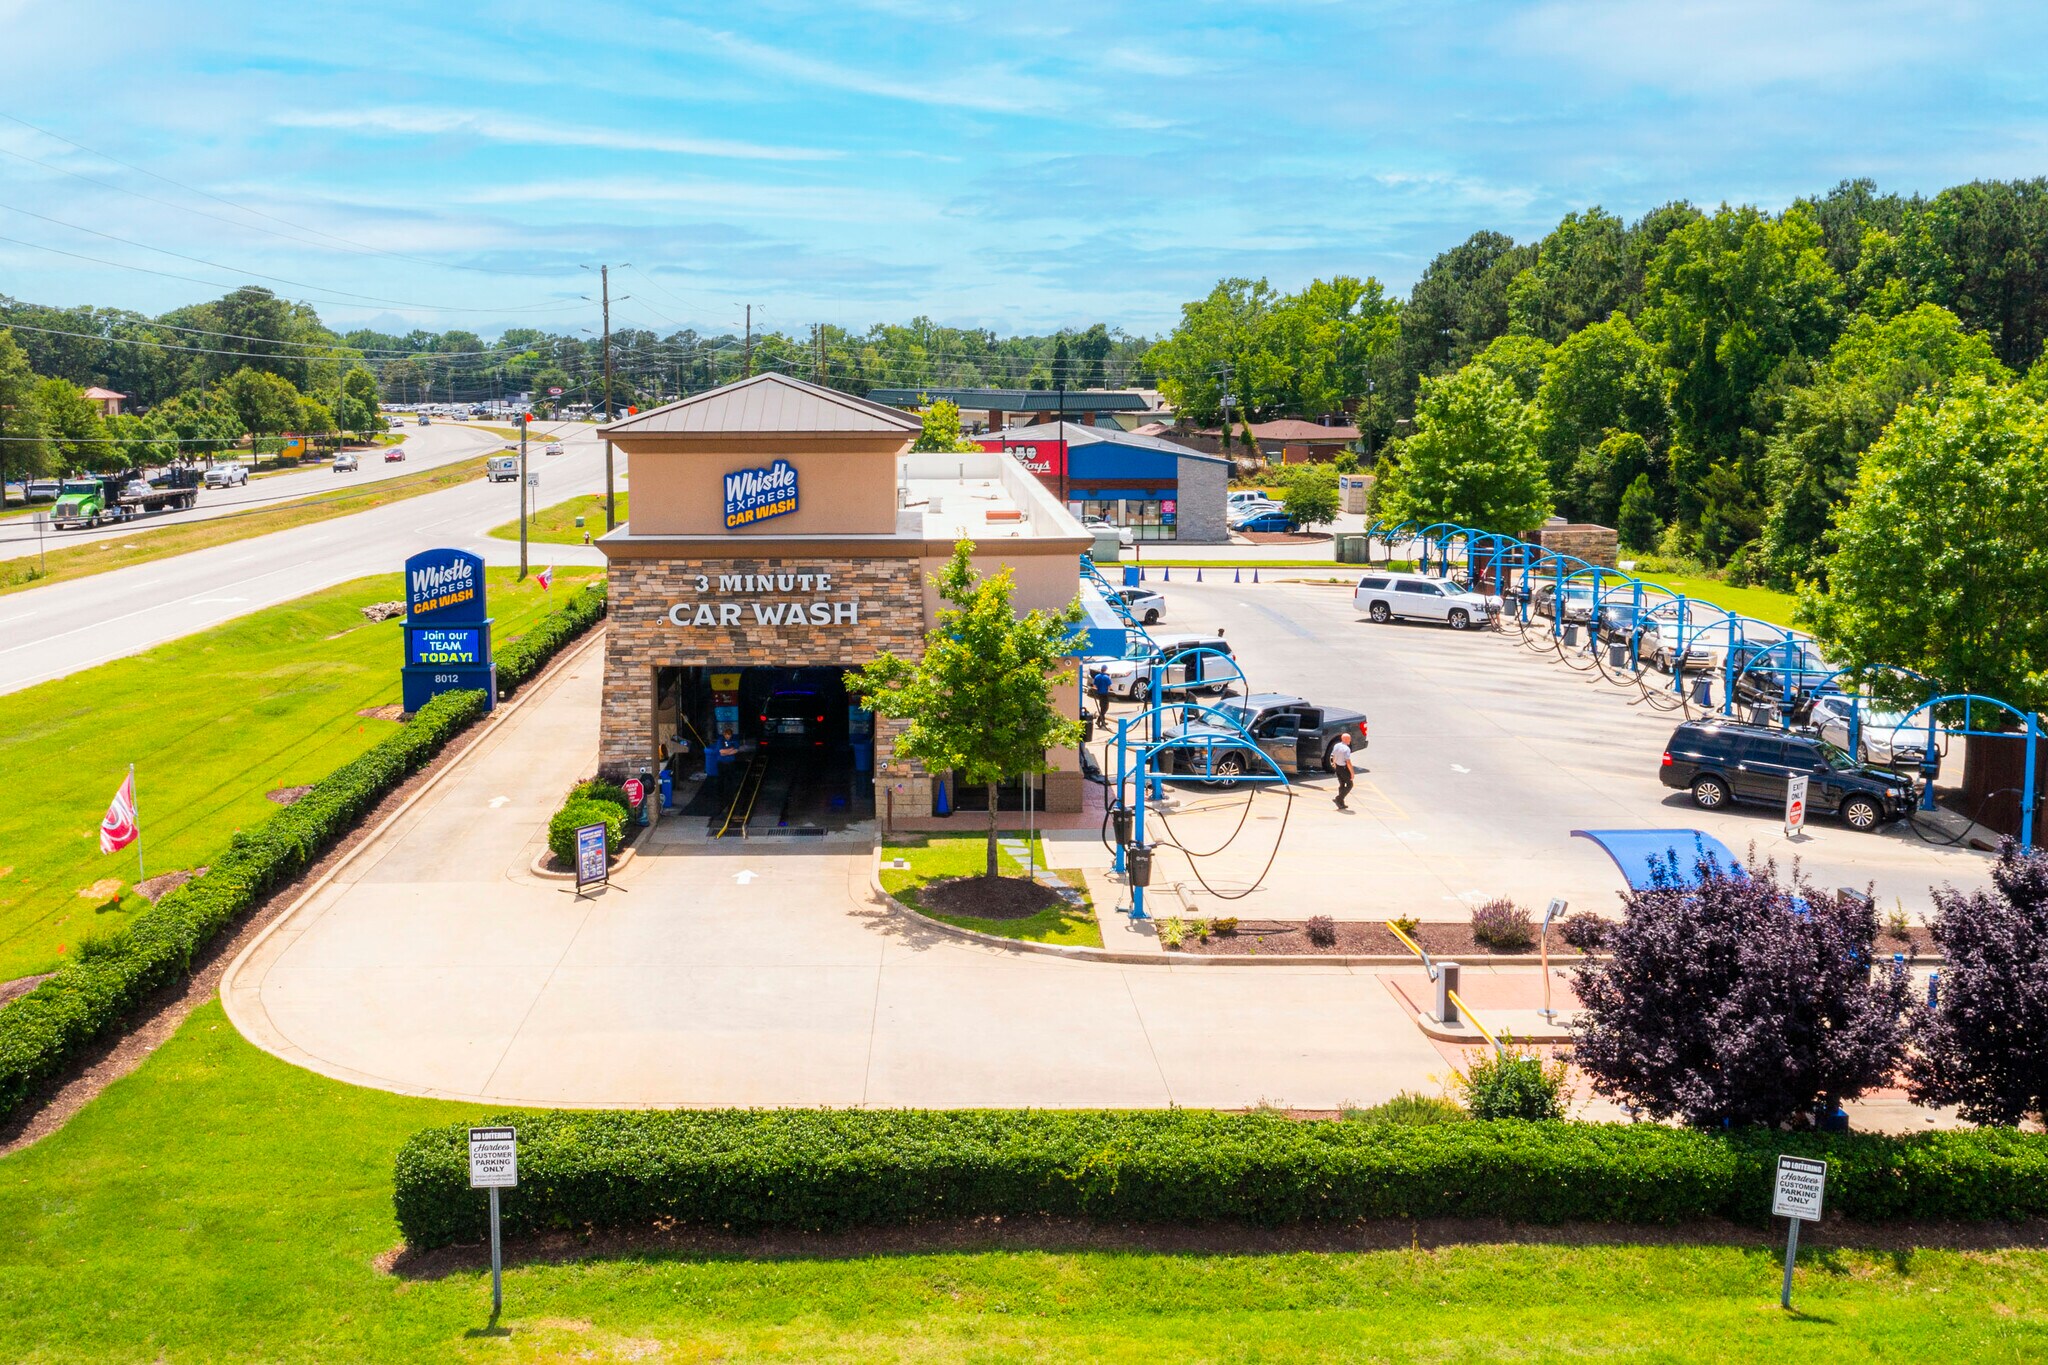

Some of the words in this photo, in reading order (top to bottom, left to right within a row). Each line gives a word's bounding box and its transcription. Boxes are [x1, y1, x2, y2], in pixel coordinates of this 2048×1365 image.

[727, 462, 795, 502] Whistle
[727, 487, 796, 514] EXPRESS
[727, 509, 754, 528] CAR
[756, 498, 796, 519] WASH
[413, 558, 472, 592] Whistle
[695, 574, 709, 592] 3
[719, 574, 832, 592] MINUTE
[414, 579, 473, 602] EXPRESS
[414, 599, 438, 614] CAR
[440, 589, 474, 605] WASH
[668, 603, 742, 626] CAR
[751, 602, 860, 626] WASH
[422, 631, 446, 640] Join
[449, 632, 468, 640] our
[430, 642, 462, 650] TEAM
[420, 652, 473, 662] TODAY!
[434, 674, 459, 683] 8012
[1793, 782, 1804, 791] EXIT
[1791, 792, 1803, 800] ONLY
[472, 1132, 482, 1140] NO
[482, 1132, 512, 1140] LOITERING
[1782, 1160, 1790, 1168] NO
[1791, 1162, 1823, 1173] LOITERING
[1780, 1181, 1820, 1192] CUSTOMER
[1780, 1188, 1816, 1198] PARKING
[1787, 1196, 1810, 1204] ONLY
